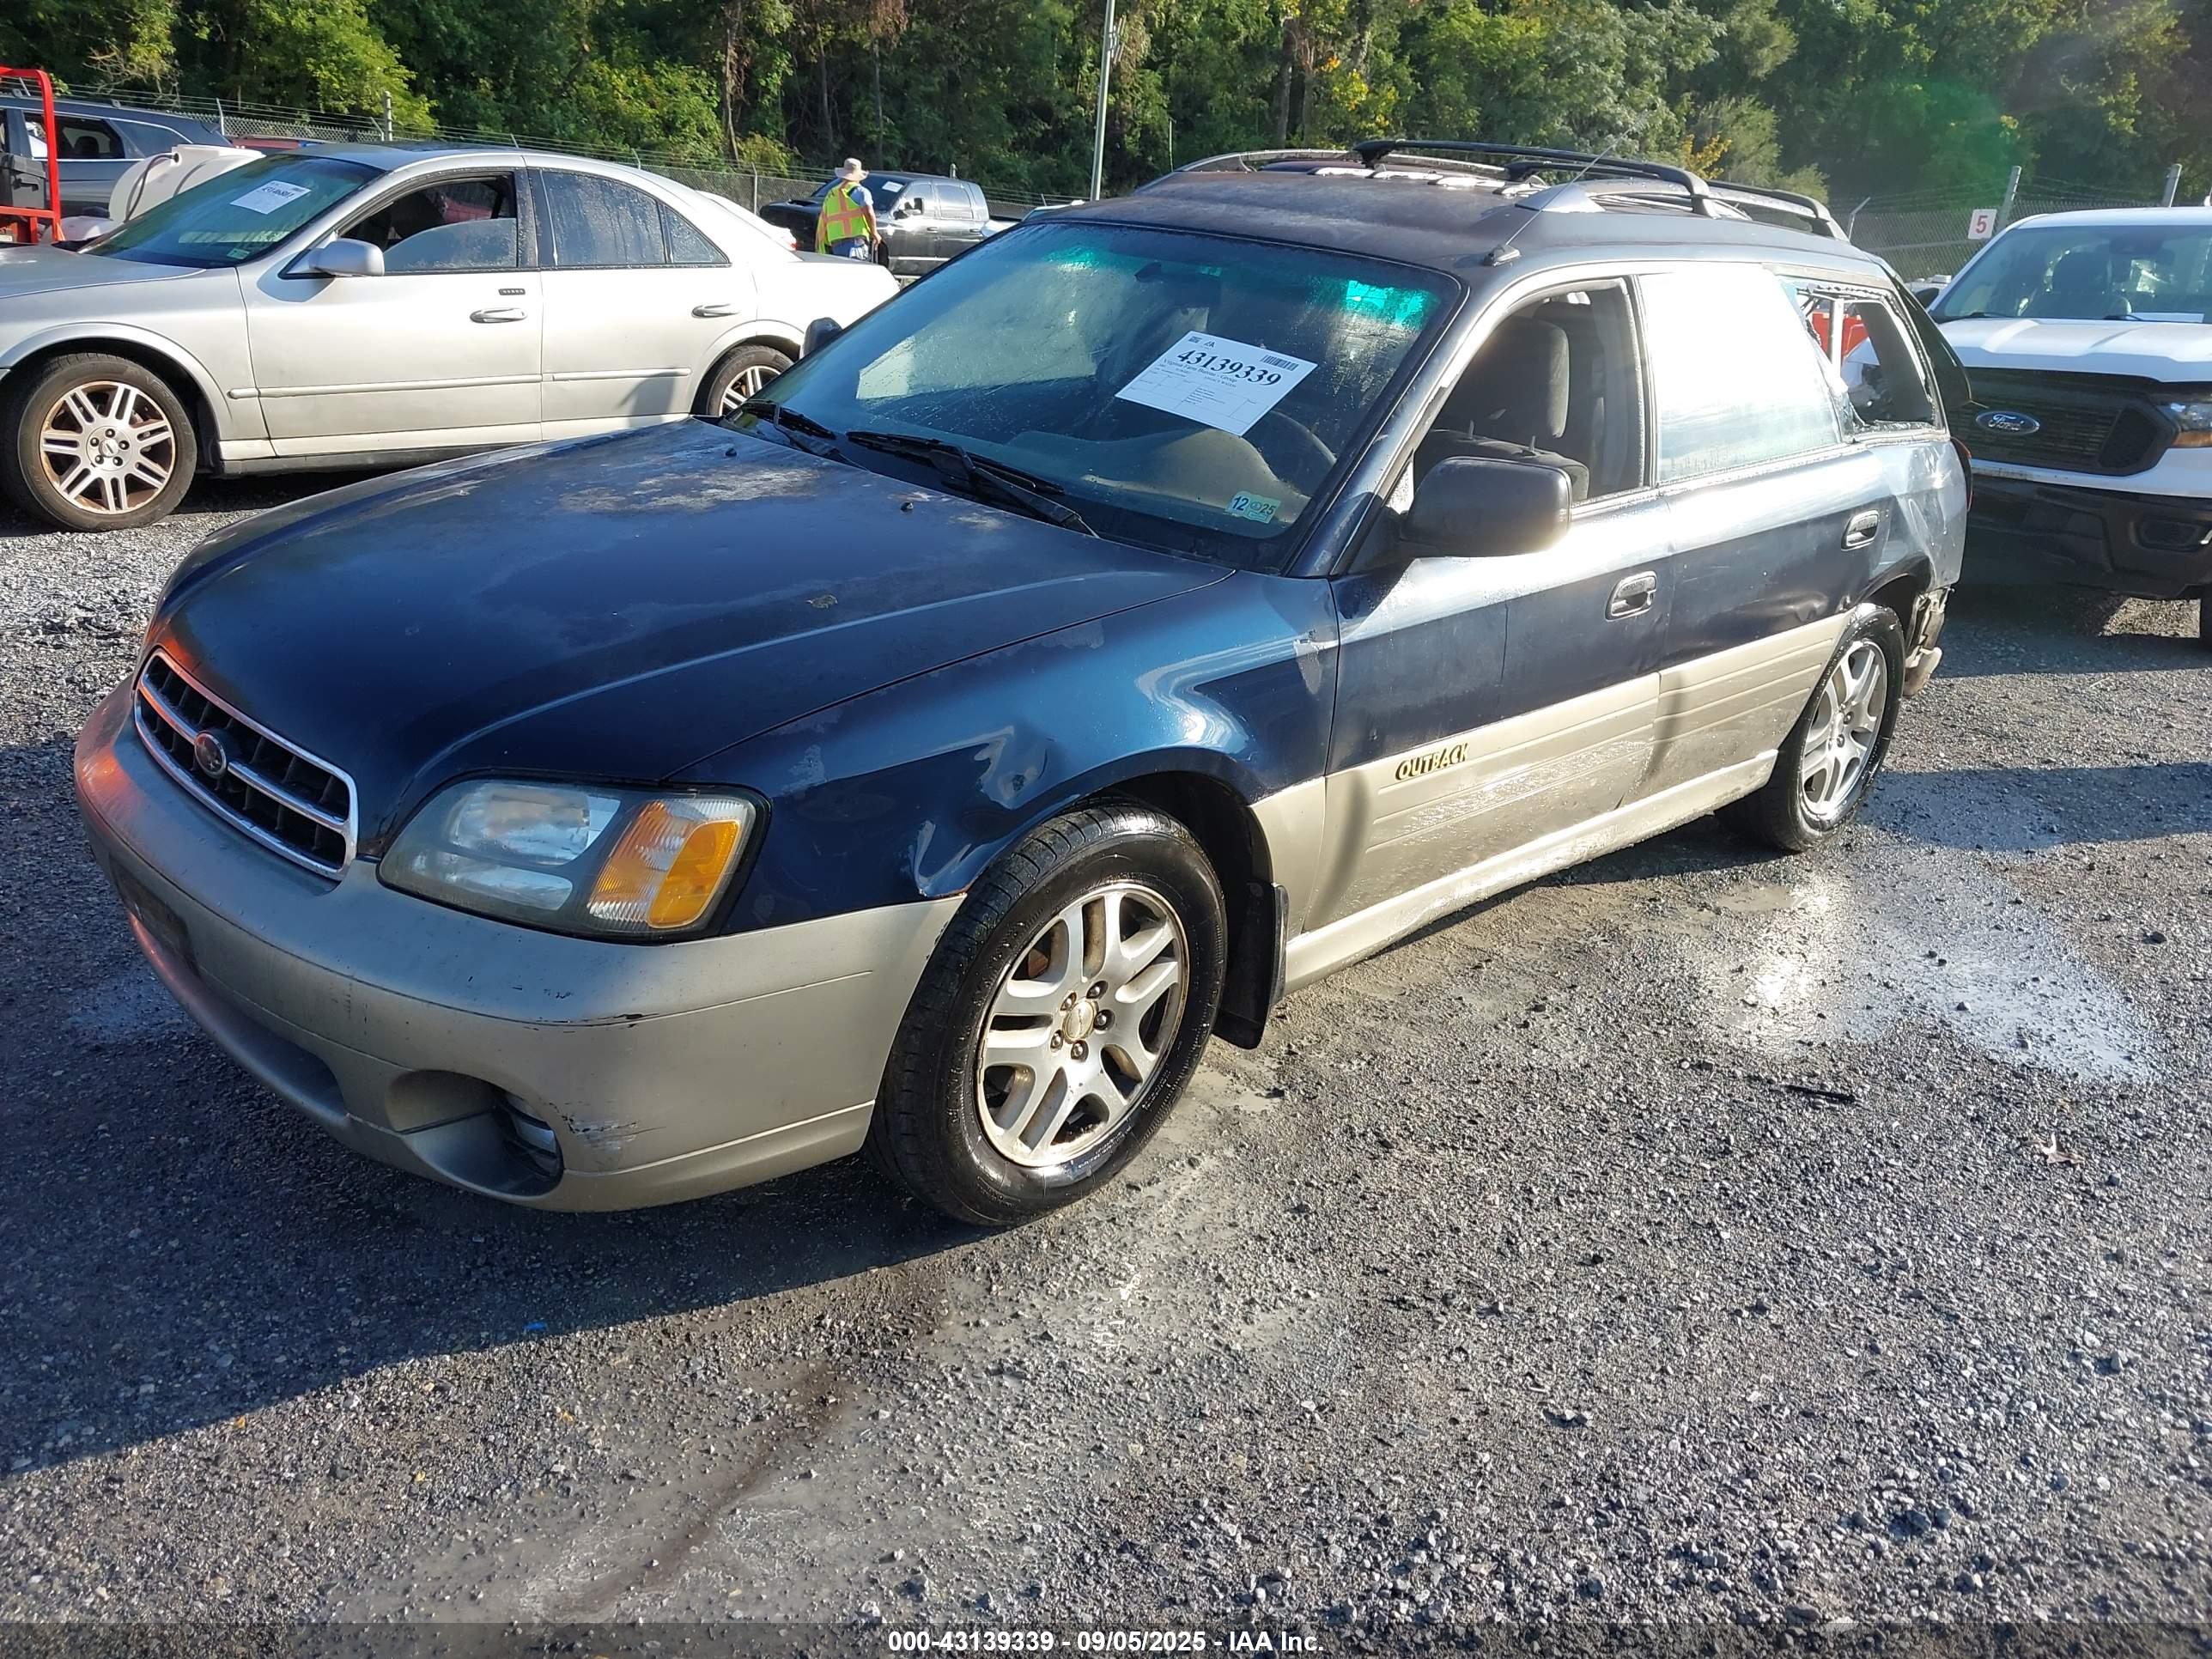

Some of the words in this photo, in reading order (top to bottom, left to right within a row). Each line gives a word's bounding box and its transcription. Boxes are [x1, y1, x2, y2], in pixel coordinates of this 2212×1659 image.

[1976, 215, 1988, 234] 5
[1176, 349, 1282, 386] 43139339
[1987, 414, 2021, 431] Ford
[1232, 495, 1249, 511] 12
[1259, 502, 1277, 515] 25
[1395, 743, 1469, 781] OUTBACK
